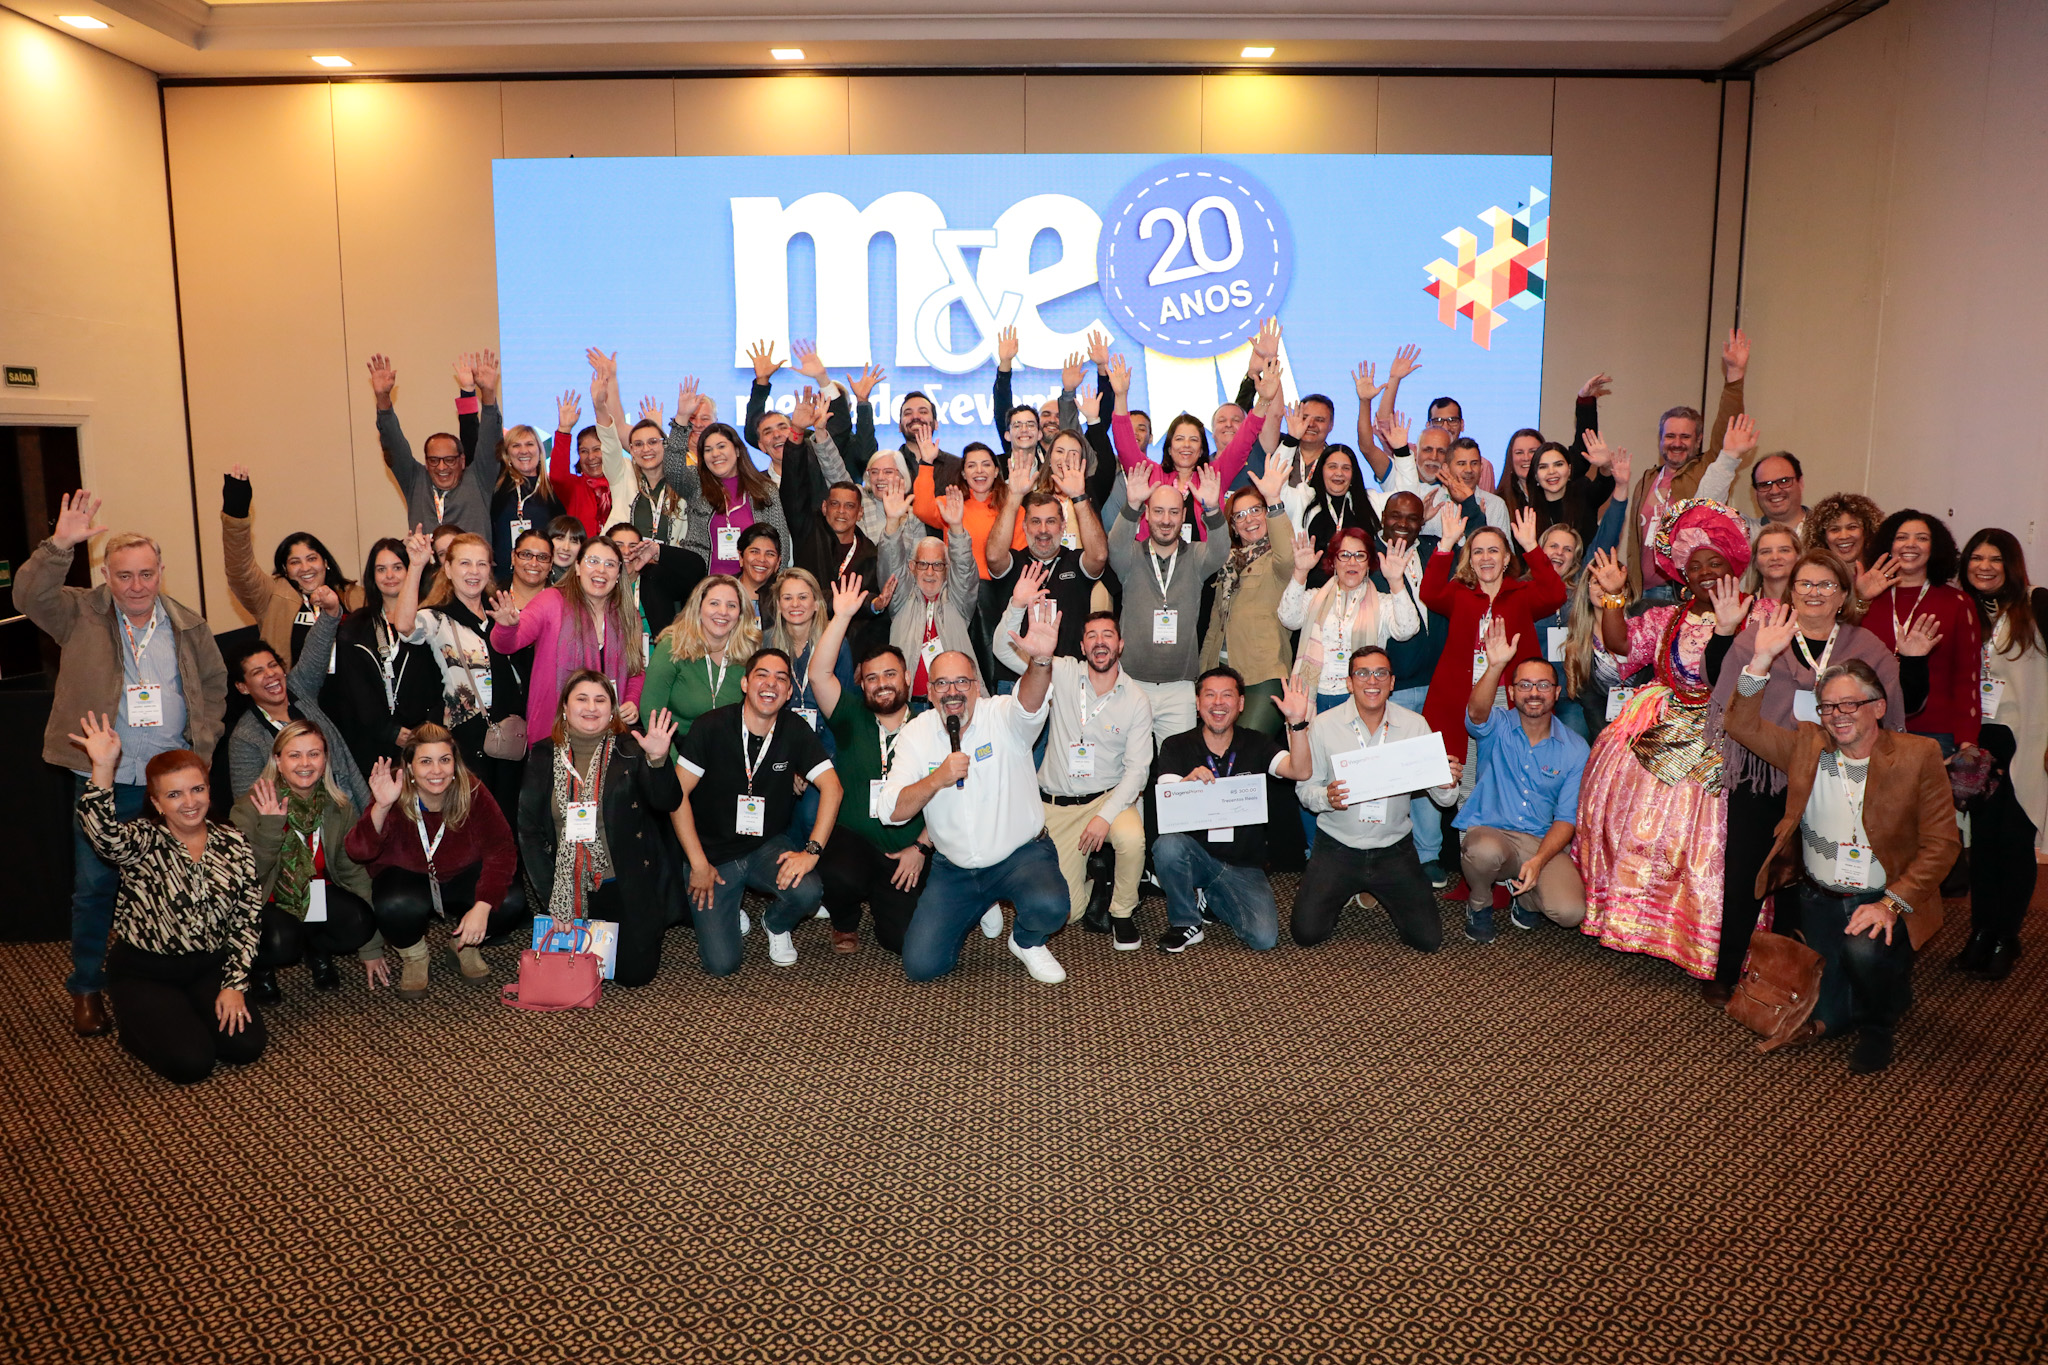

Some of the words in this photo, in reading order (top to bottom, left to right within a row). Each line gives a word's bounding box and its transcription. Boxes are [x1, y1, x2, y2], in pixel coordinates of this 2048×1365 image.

[1139, 195, 1244, 286] 20
[1160, 279, 1253, 325] ANOS
[8, 371, 33, 382] SAÍDA
